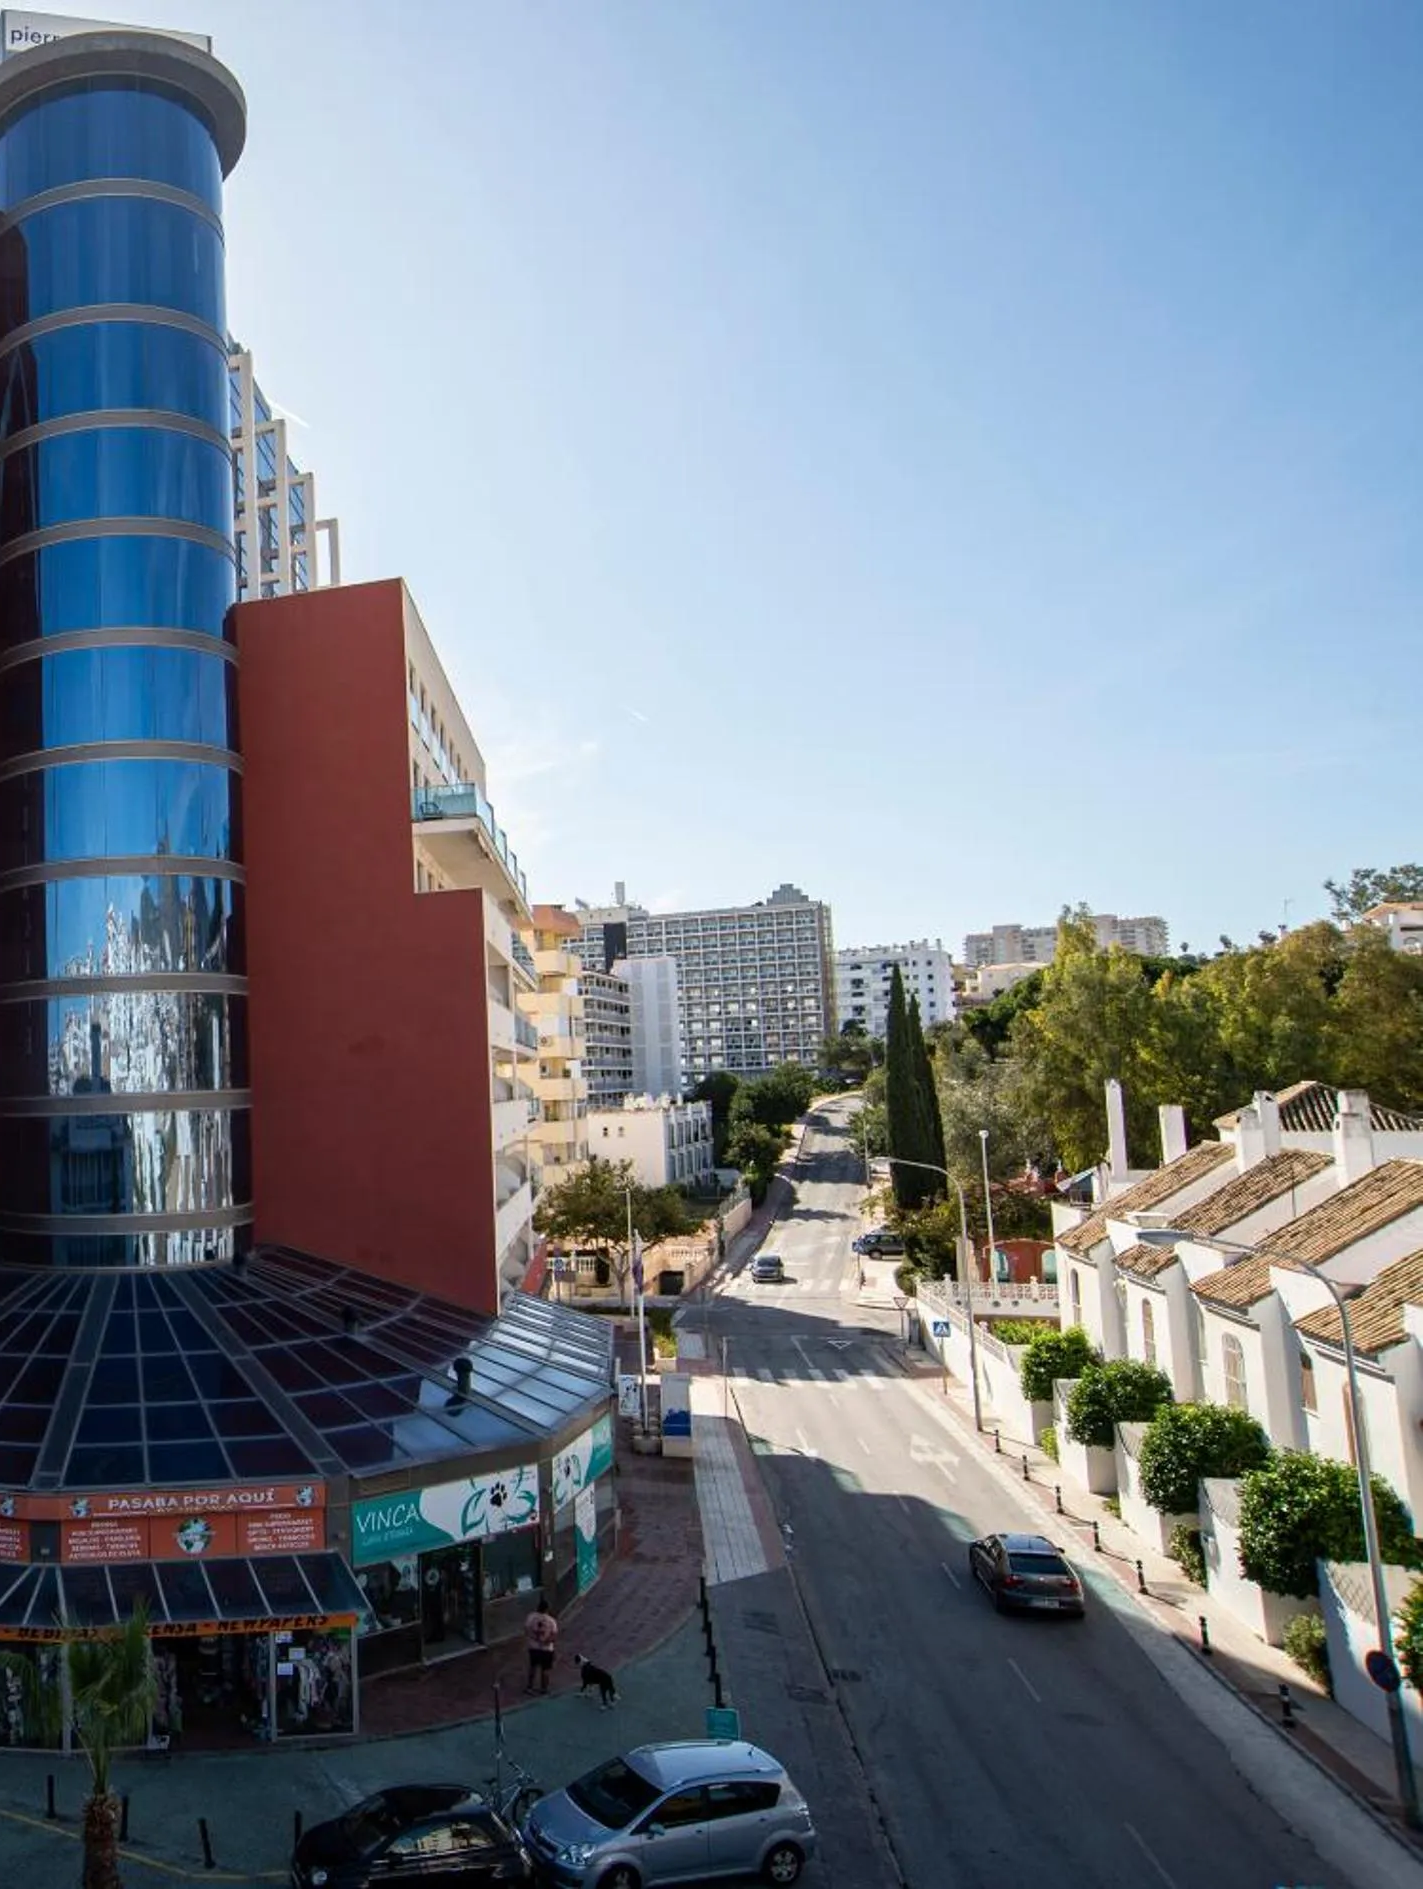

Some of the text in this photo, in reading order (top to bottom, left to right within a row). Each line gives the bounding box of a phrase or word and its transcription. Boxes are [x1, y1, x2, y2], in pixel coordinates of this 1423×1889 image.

[11, 25, 60, 45] pierr
[108, 1497, 178, 1510] PASABA
[184, 1494, 220, 1506] POR
[356, 1503, 420, 1533] VINCA
